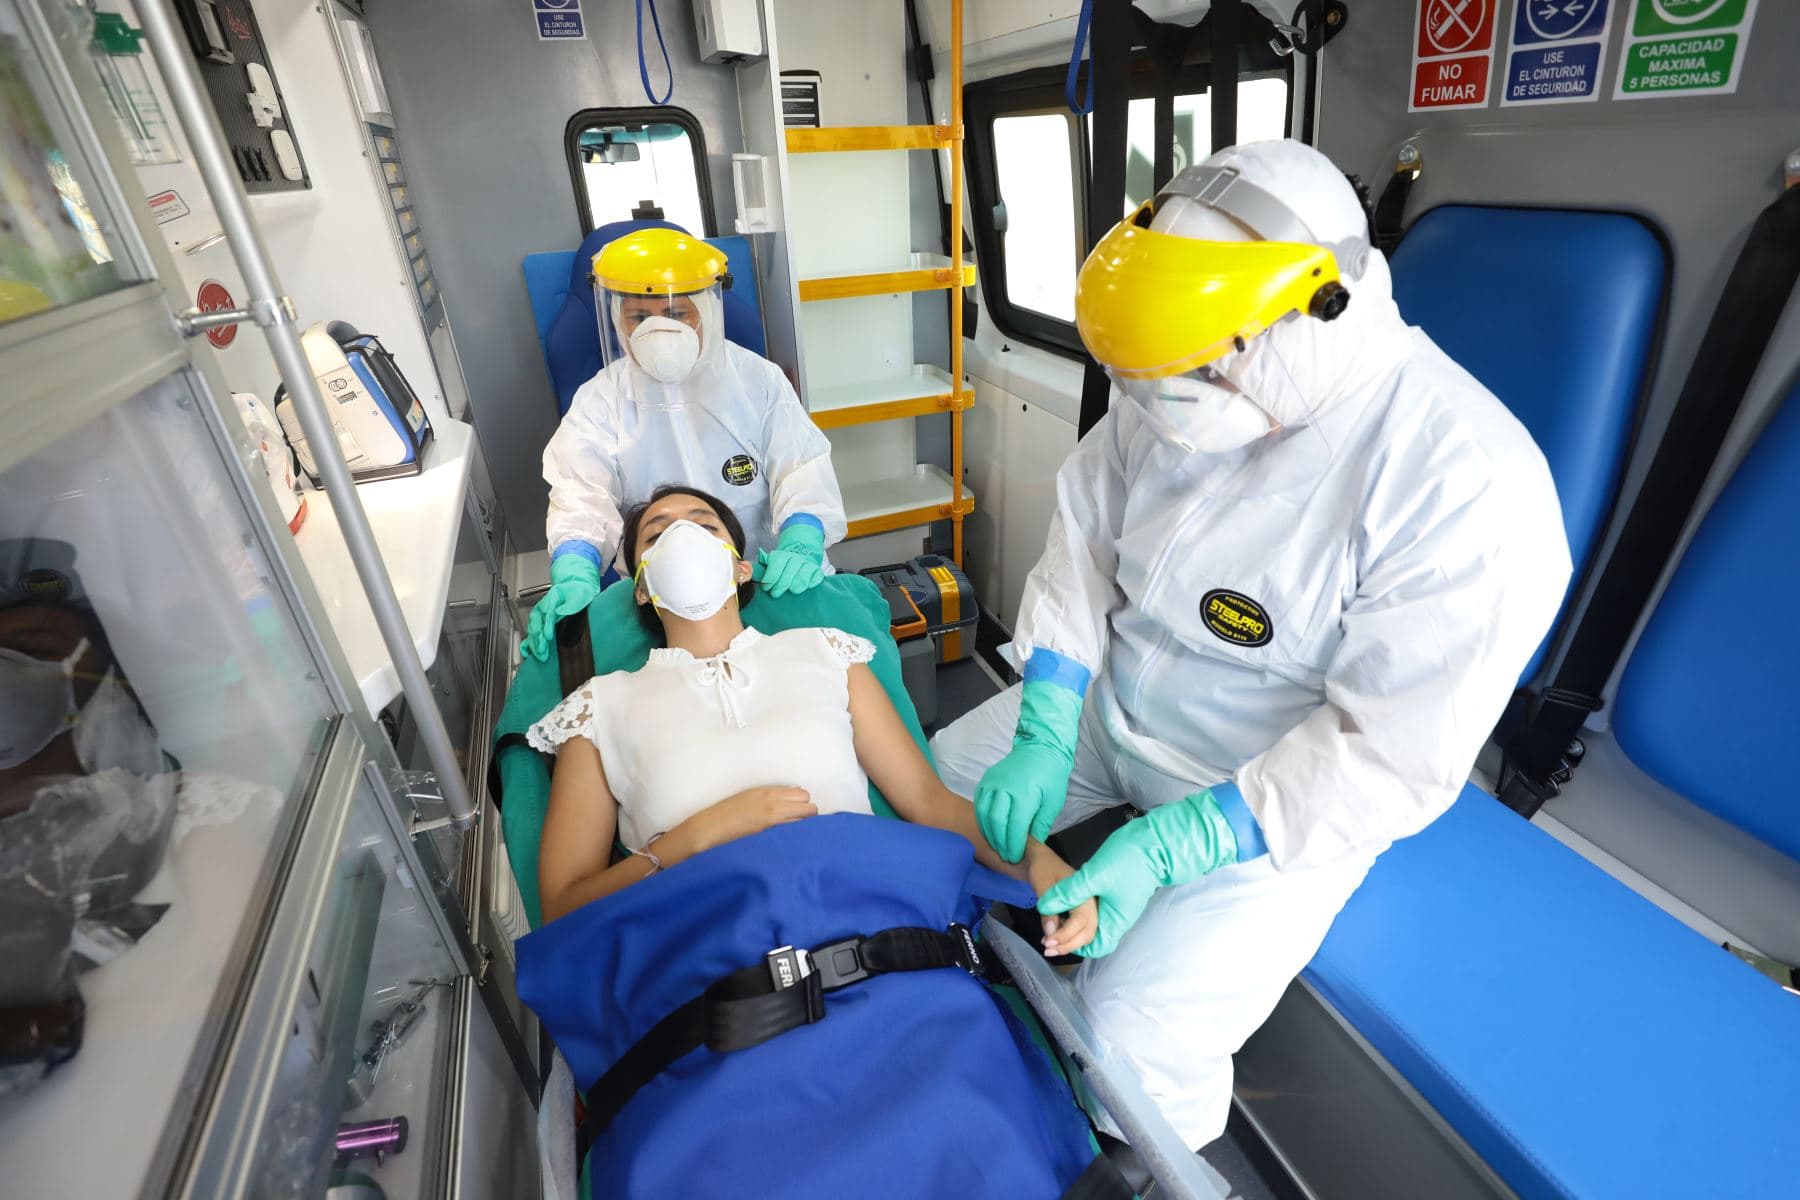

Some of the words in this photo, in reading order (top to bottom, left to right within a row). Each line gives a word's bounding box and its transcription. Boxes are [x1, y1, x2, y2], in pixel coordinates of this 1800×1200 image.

[1638, 38, 1725, 58] CAPACIDAD
[1543, 51, 1564, 64] USE
[1648, 57, 1706, 73] MAXIMA
[1438, 63, 1462, 80] NO
[1519, 70, 1531, 82] EL
[1533, 65, 1586, 80] CINTURON
[1629, 77, 1639, 89] 5
[1640, 71, 1722, 88] PERSONAS
[1421, 84, 1476, 102] FUMAR
[1513, 85, 1526, 96] DE
[1528, 80, 1587, 96] SEGURIDAD
[1225, 596, 1260, 616] PROTECTIVE
[1208, 599, 1265, 635] STEELPRO
[1218, 614, 1249, 631] SAFETY
[961, 928, 980, 964] FERNO
[776, 958, 795, 988] FER
